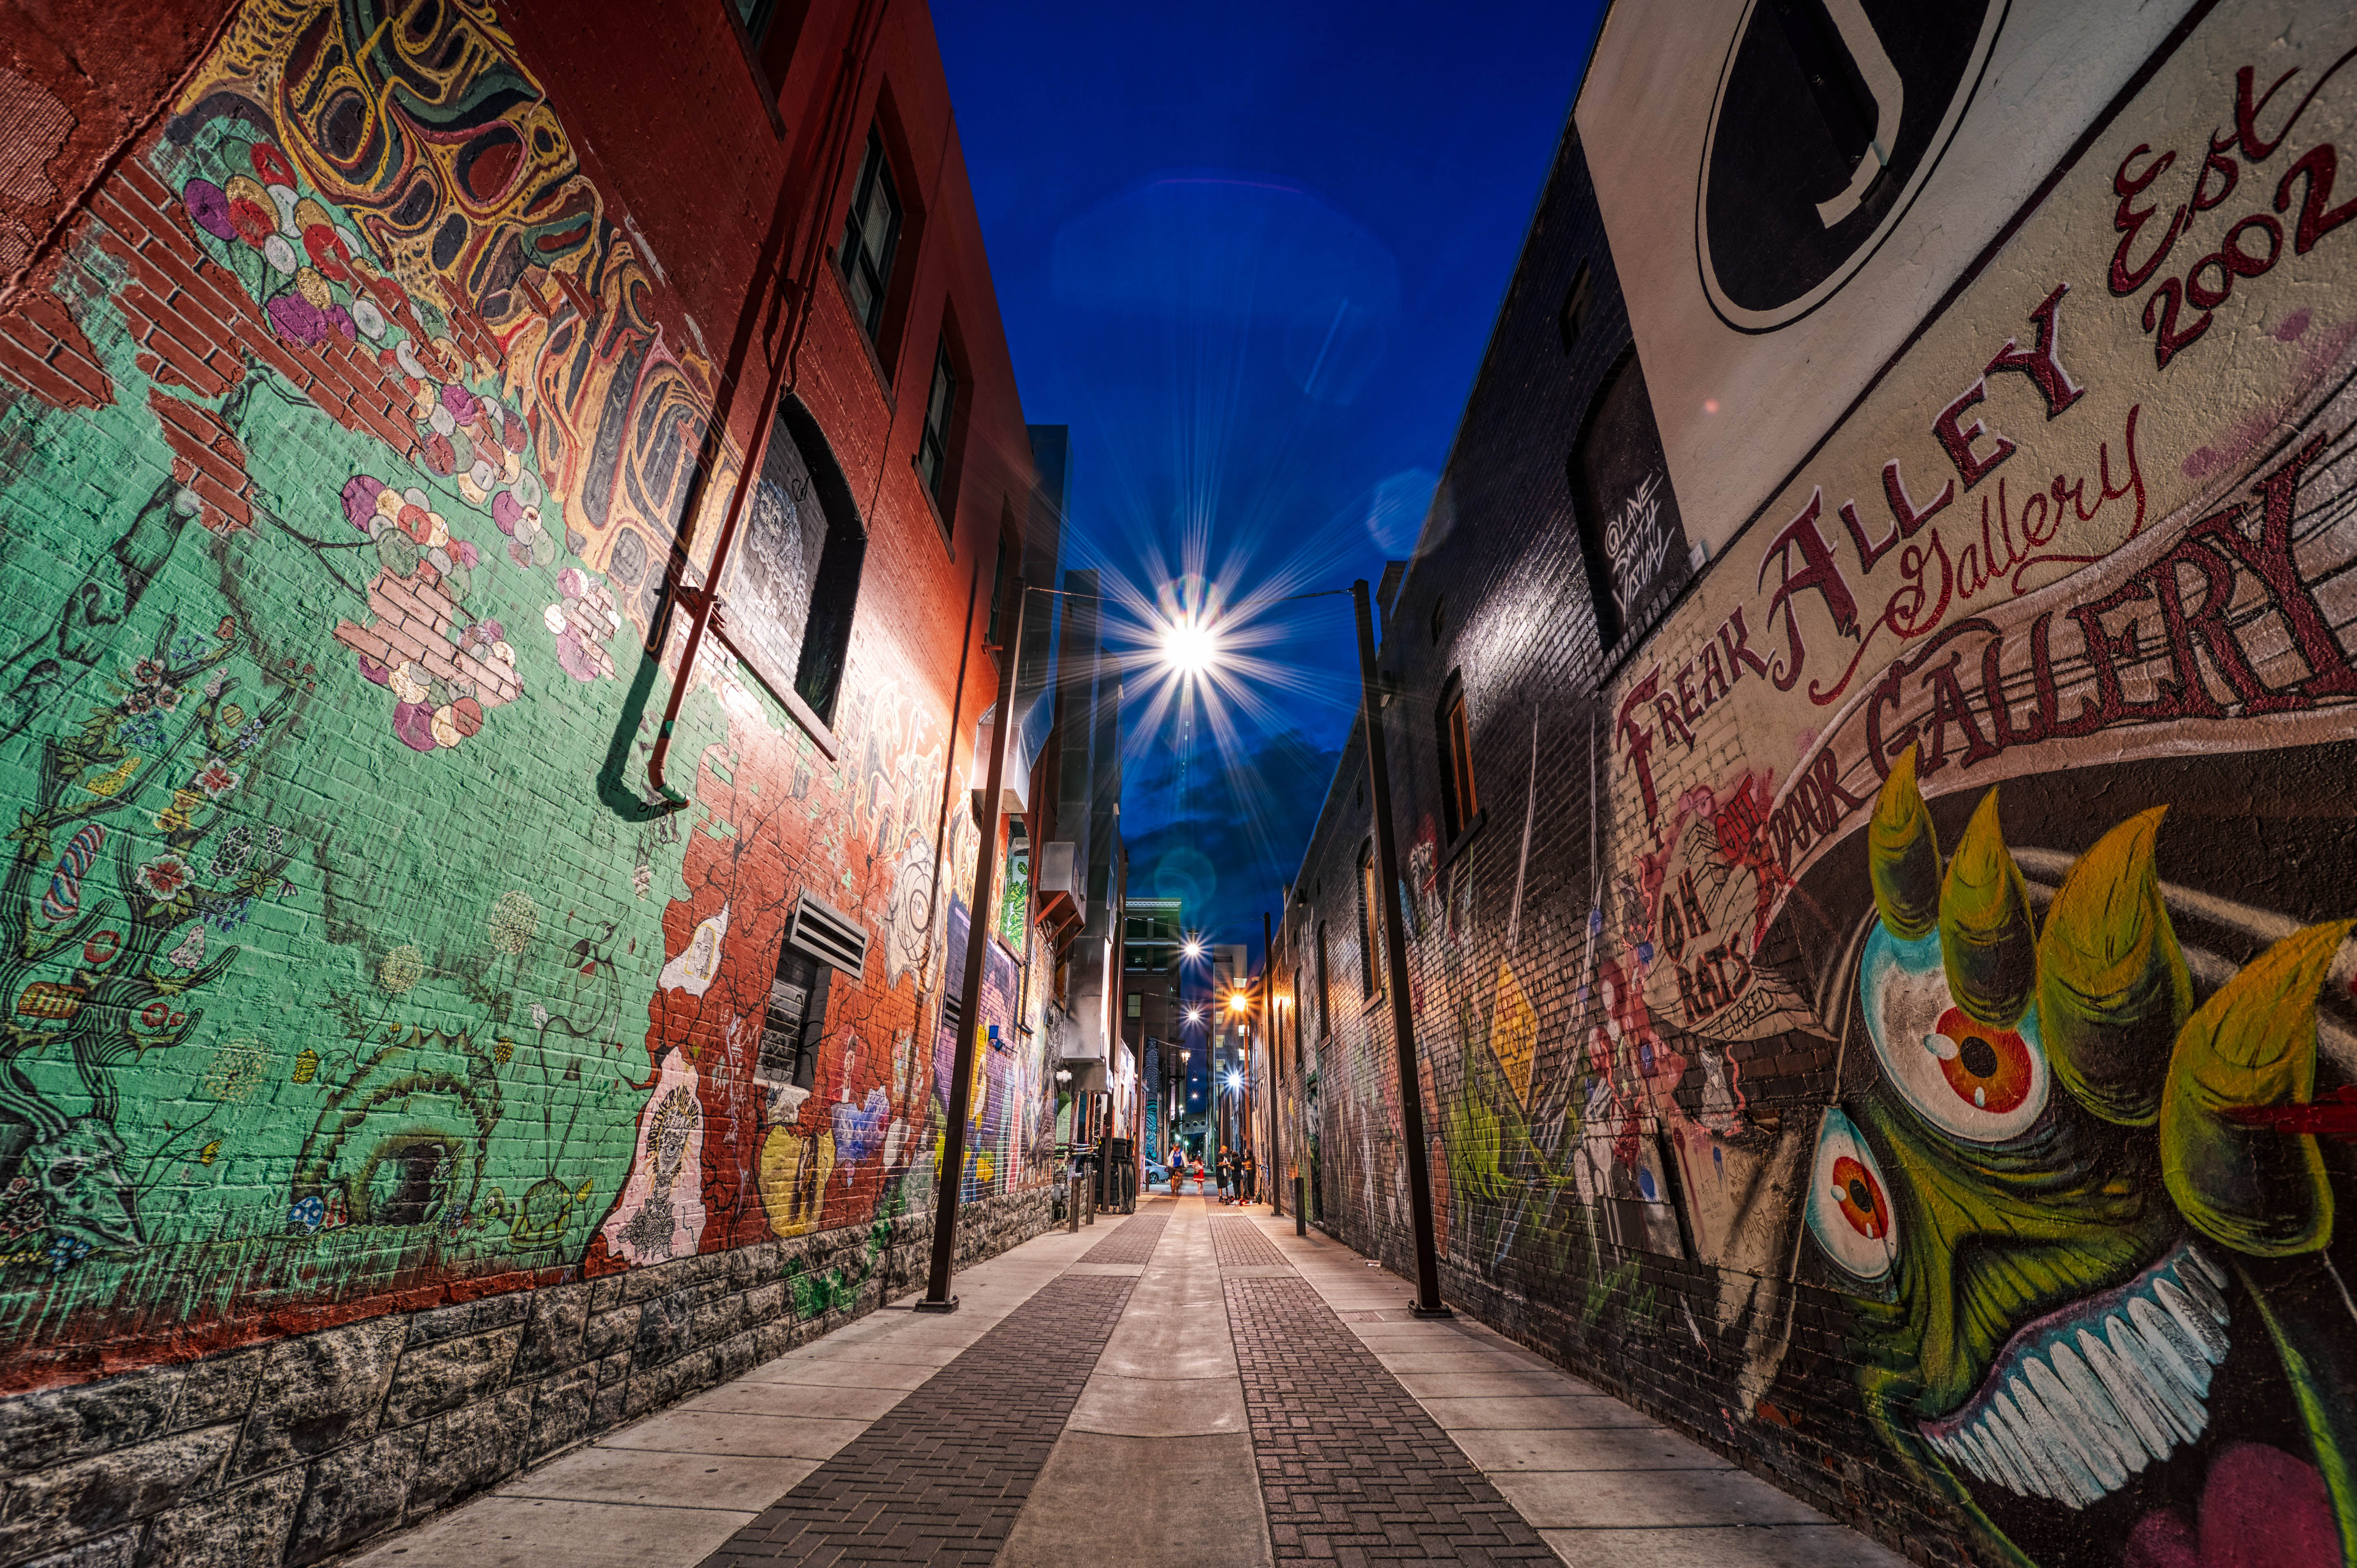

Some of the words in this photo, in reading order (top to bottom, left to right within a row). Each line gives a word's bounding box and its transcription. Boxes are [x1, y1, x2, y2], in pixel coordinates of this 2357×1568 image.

[2142, 143, 2357, 371] 2002
[1616, 602, 1776, 853] FREAK
[1758, 281, 2085, 692] ALLEY
[1715, 773, 1763, 860] OUT
[1769, 747, 1867, 877] DOOR
[1867, 430, 2357, 782] GALLERY
[1661, 868, 1711, 962] OH
[1676, 931, 1752, 1025] RATS
[645, 1089, 676, 1160] TOGETHER
